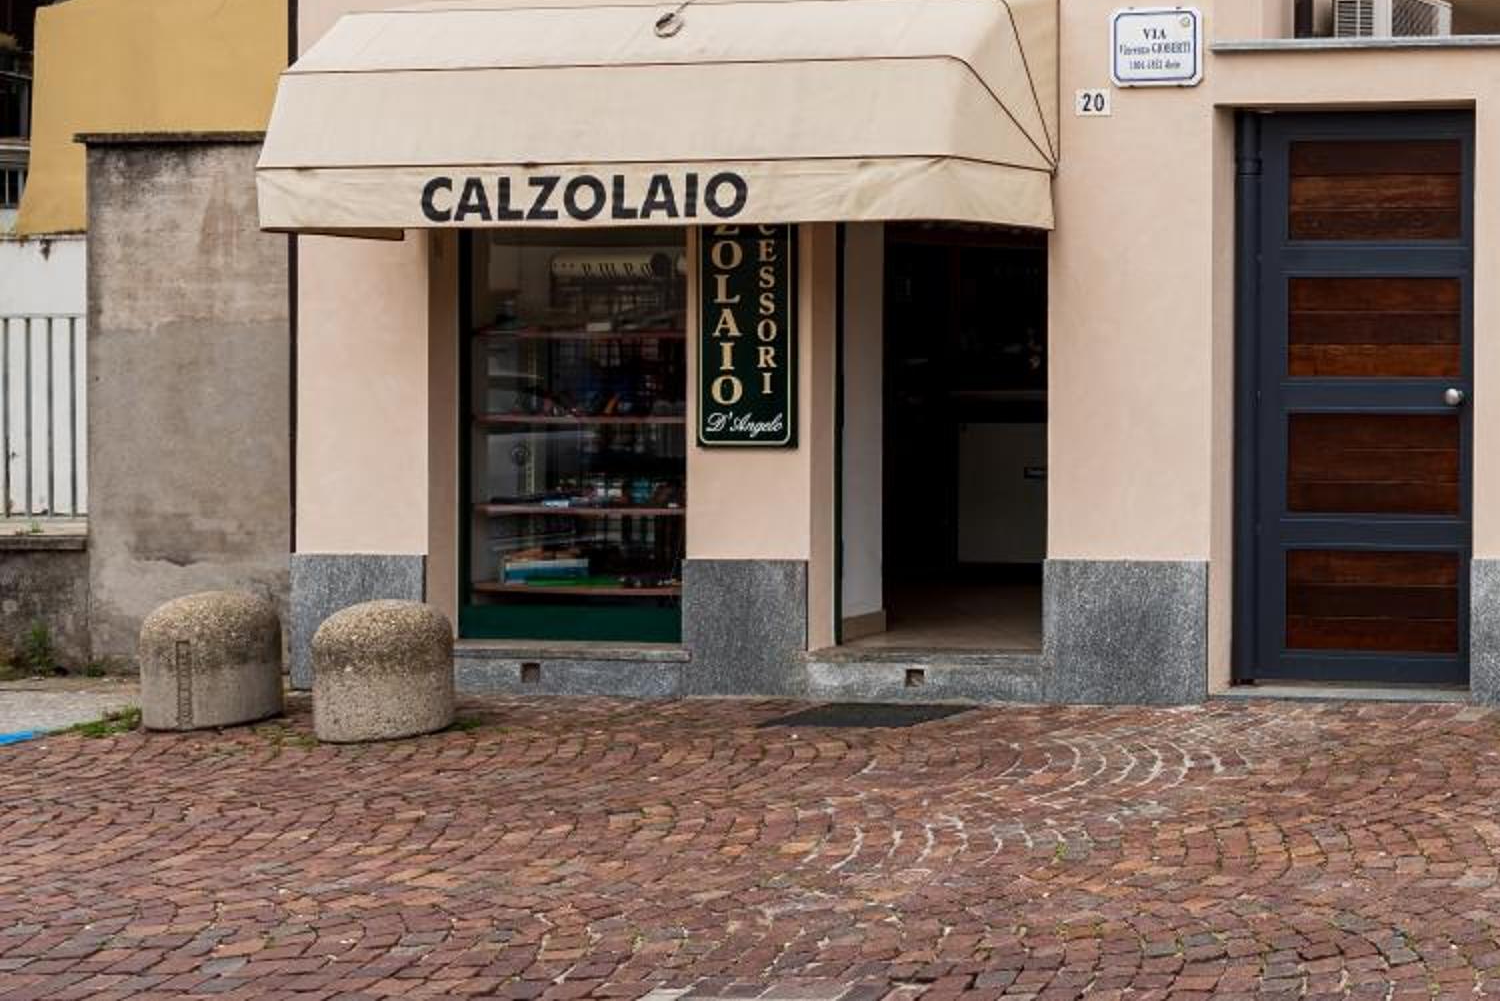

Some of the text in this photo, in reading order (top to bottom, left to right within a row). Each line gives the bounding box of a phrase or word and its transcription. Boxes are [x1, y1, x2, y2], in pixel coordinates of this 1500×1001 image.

[1143, 28, 1167, 40] VIA
[1082, 93, 1105, 112] 20
[421, 172, 748, 222] CALZOLAIO
[705, 412, 784, 438] D'Angelo
